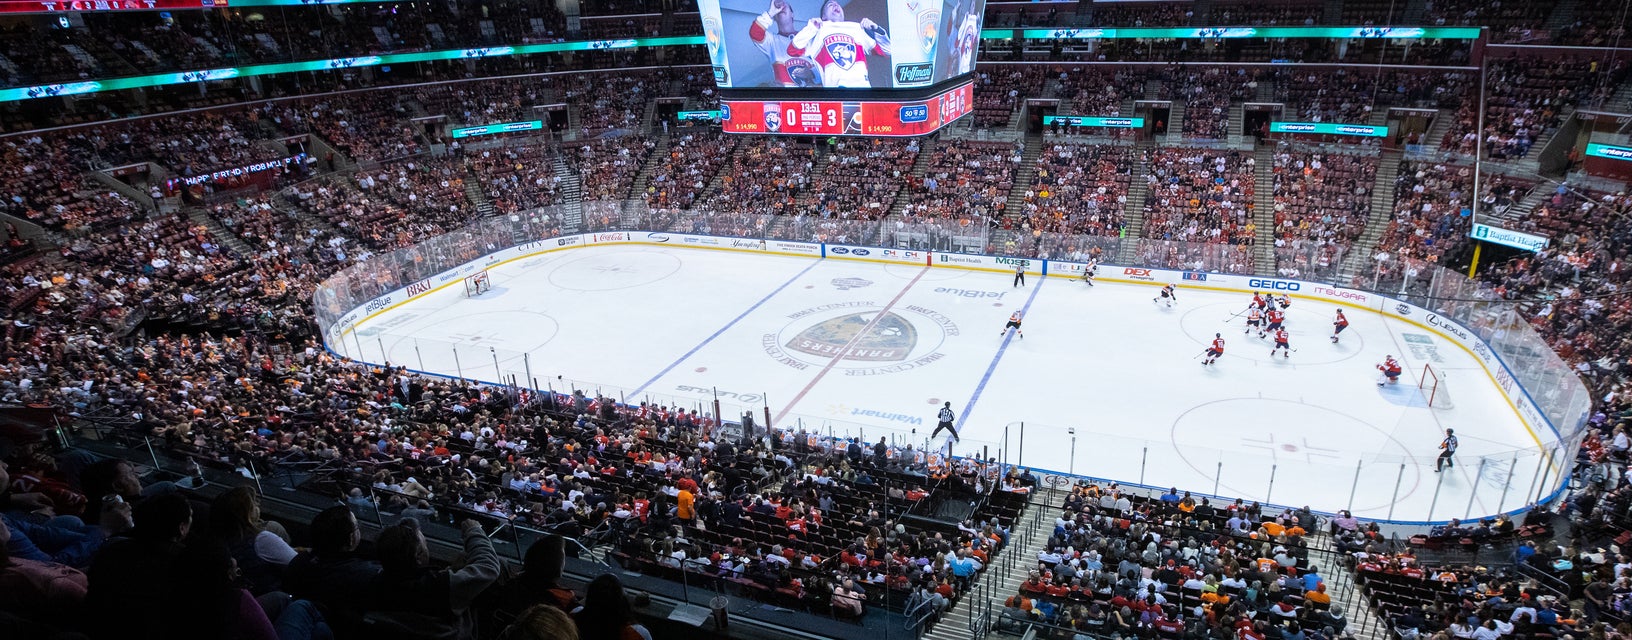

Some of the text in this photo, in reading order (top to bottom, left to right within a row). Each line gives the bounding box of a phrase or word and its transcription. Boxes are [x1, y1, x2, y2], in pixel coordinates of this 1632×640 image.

[801, 103, 820, 113] 13:51
[786, 109, 796, 126] 0
[827, 109, 837, 127] 3
[250, 163, 266, 172] ROB
[1124, 267, 1152, 276] DEX
[934, 286, 1008, 299] jetBlue
[1249, 279, 1300, 291] GEICO
[365, 296, 392, 315] jetBlue
[1439, 320, 1467, 340] LEXUS
[851, 407, 923, 426] Walmart
